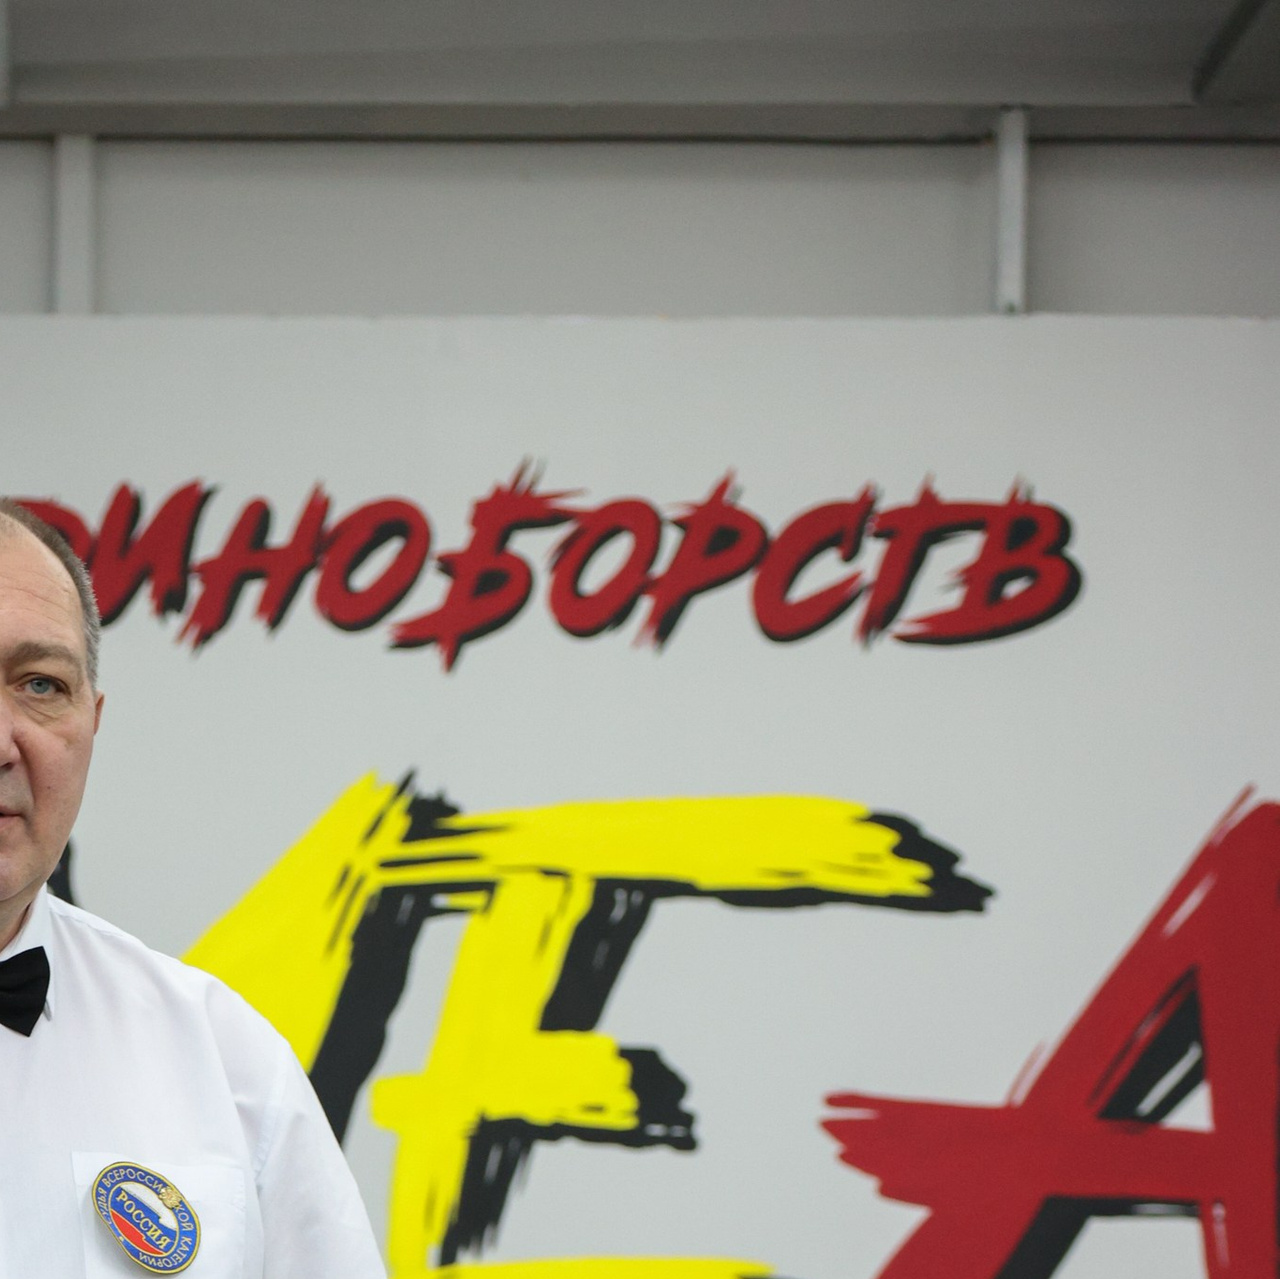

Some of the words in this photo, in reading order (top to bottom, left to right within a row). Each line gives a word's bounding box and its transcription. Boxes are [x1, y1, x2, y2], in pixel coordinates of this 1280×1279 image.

[101, 1168, 194, 1232] ВСЕРОССИКОЙ
[115, 1191, 171, 1250] РОССИЯ
[138, 1235, 193, 1268] КАТЕГОРИИ
